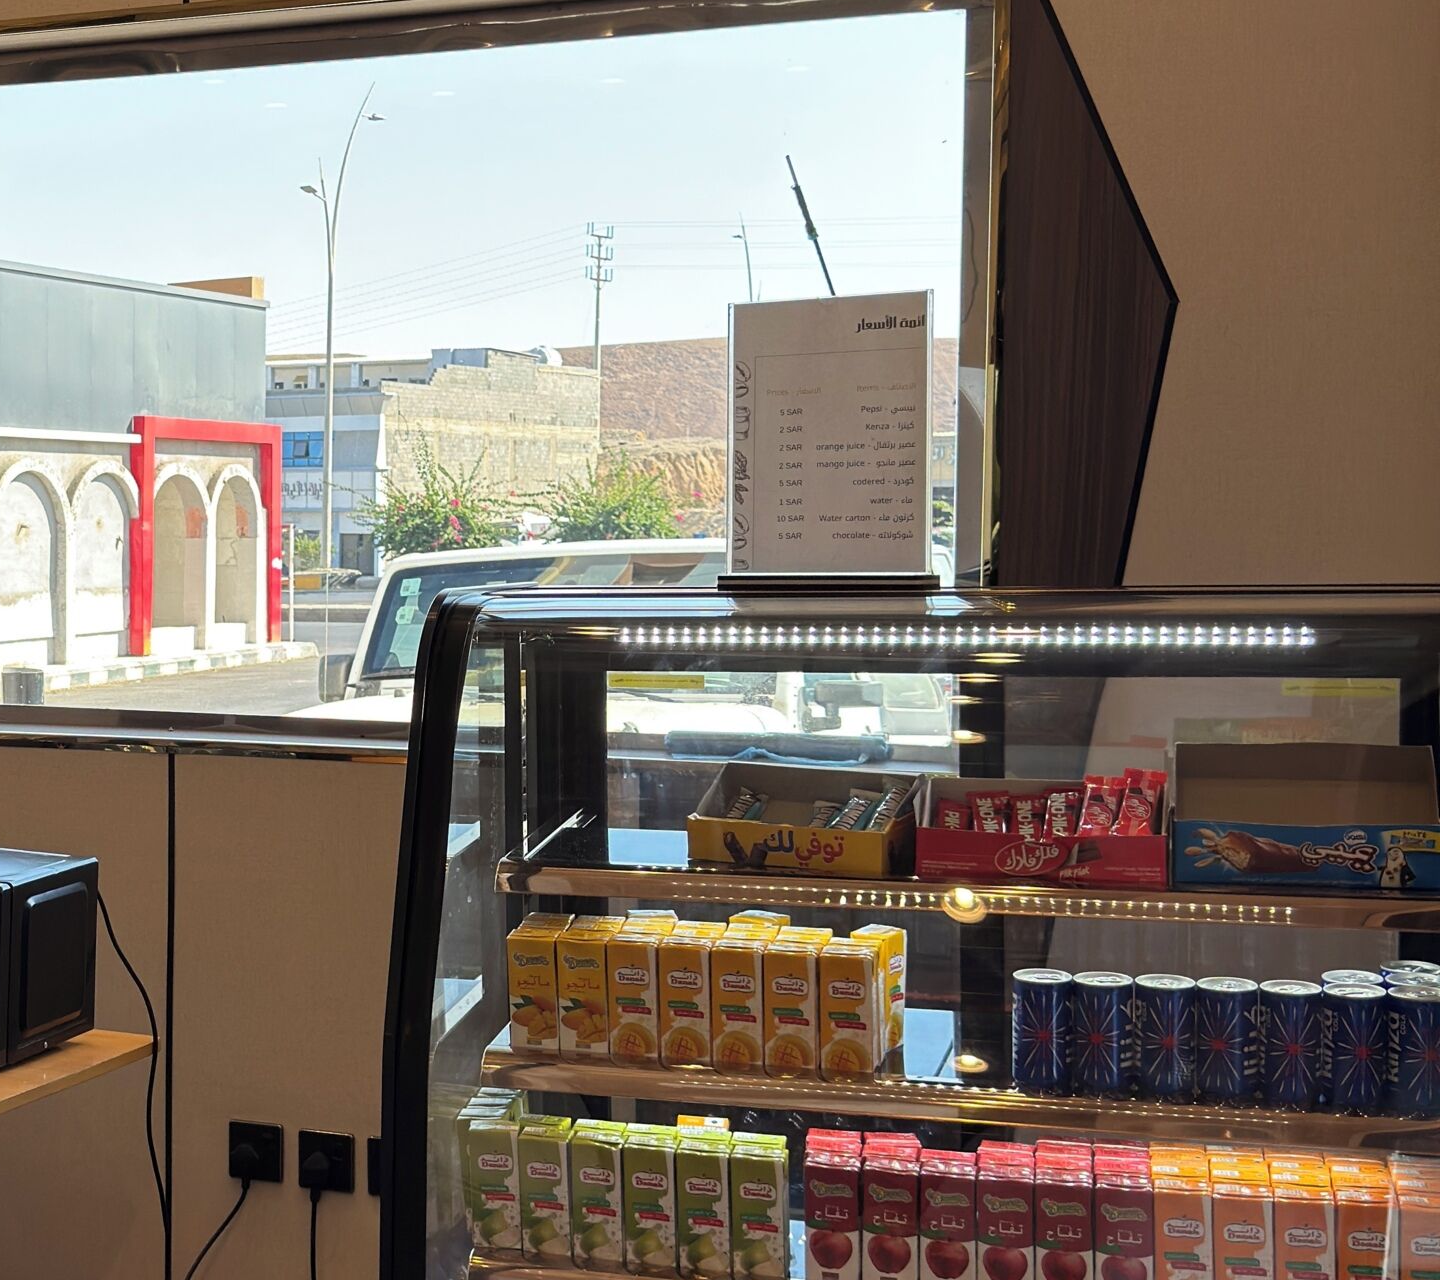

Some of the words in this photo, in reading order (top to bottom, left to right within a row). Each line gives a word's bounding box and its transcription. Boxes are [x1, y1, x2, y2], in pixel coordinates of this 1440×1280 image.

[786, 408, 803, 416] SAR
[860, 405, 882, 414] Pepsi
[786, 425, 803, 433] SAR
[786, 443, 802, 451] SAR
[816, 444, 844, 452] orange
[846, 442, 865, 452] juice
[786, 462, 803, 470] SAR
[816, 461, 844, 469] mango
[846, 460, 865, 469] juice
[786, 479, 803, 487] SAR
[852, 478, 885, 486] codered
[785, 498, 803, 506] SAR
[787, 514, 805, 522] SAR
[785, 532, 802, 540] SAR
[832, 530, 870, 539] chocolate
[794, 832, 845, 867] توفي
